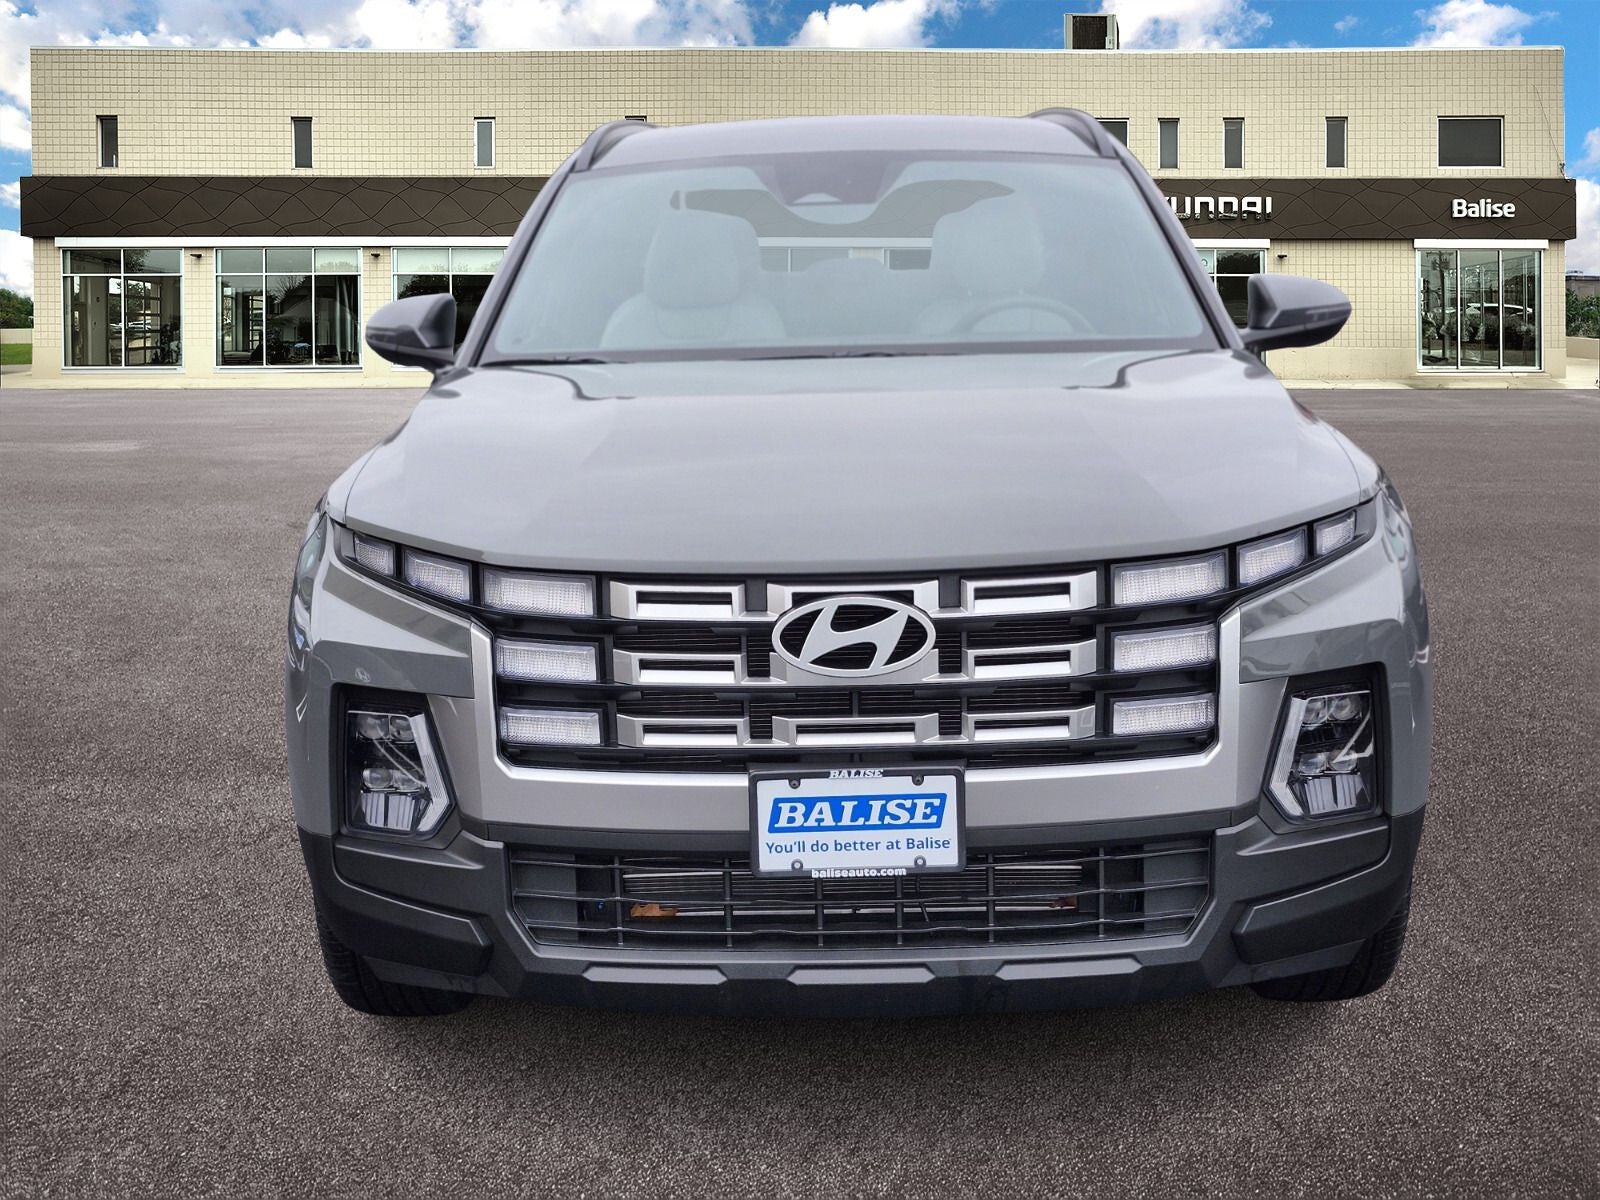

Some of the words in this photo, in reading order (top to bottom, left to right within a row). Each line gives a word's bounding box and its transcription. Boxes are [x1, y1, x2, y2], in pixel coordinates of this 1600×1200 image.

[1165, 196, 1273, 219] UNDAI
[1452, 198, 1516, 218] Balise
[829, 769, 884, 779] BALISE
[774, 798, 941, 828] BALISE
[766, 841, 806, 854] You'll
[810, 841, 829, 853] do
[834, 839, 881, 852] better
[886, 839, 902, 850] at
[906, 837, 950, 850] Balise
[811, 867, 907, 879] baliseauto.com
